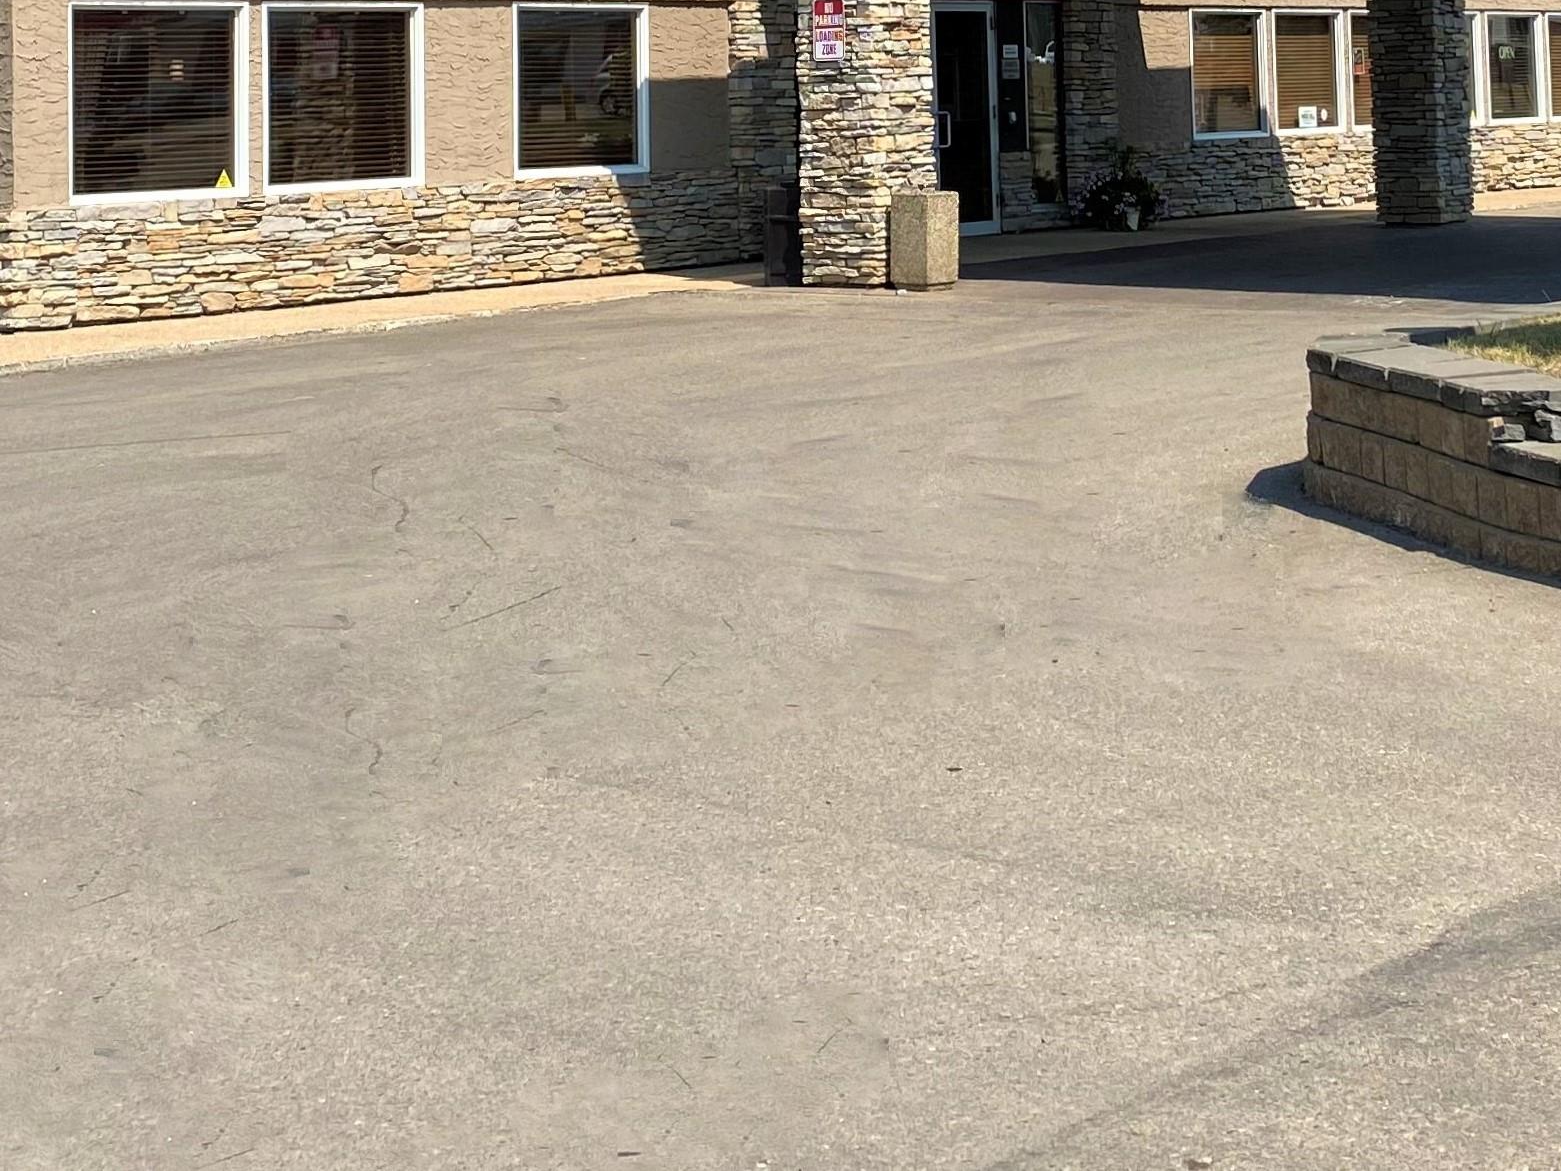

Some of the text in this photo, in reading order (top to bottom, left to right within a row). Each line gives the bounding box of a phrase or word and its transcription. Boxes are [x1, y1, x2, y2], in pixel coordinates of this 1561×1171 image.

[823, 2, 834, 14] NO
[815, 14, 844, 26] PARKING
[816, 30, 844, 42] LOADING
[821, 43, 837, 55] ZONE
